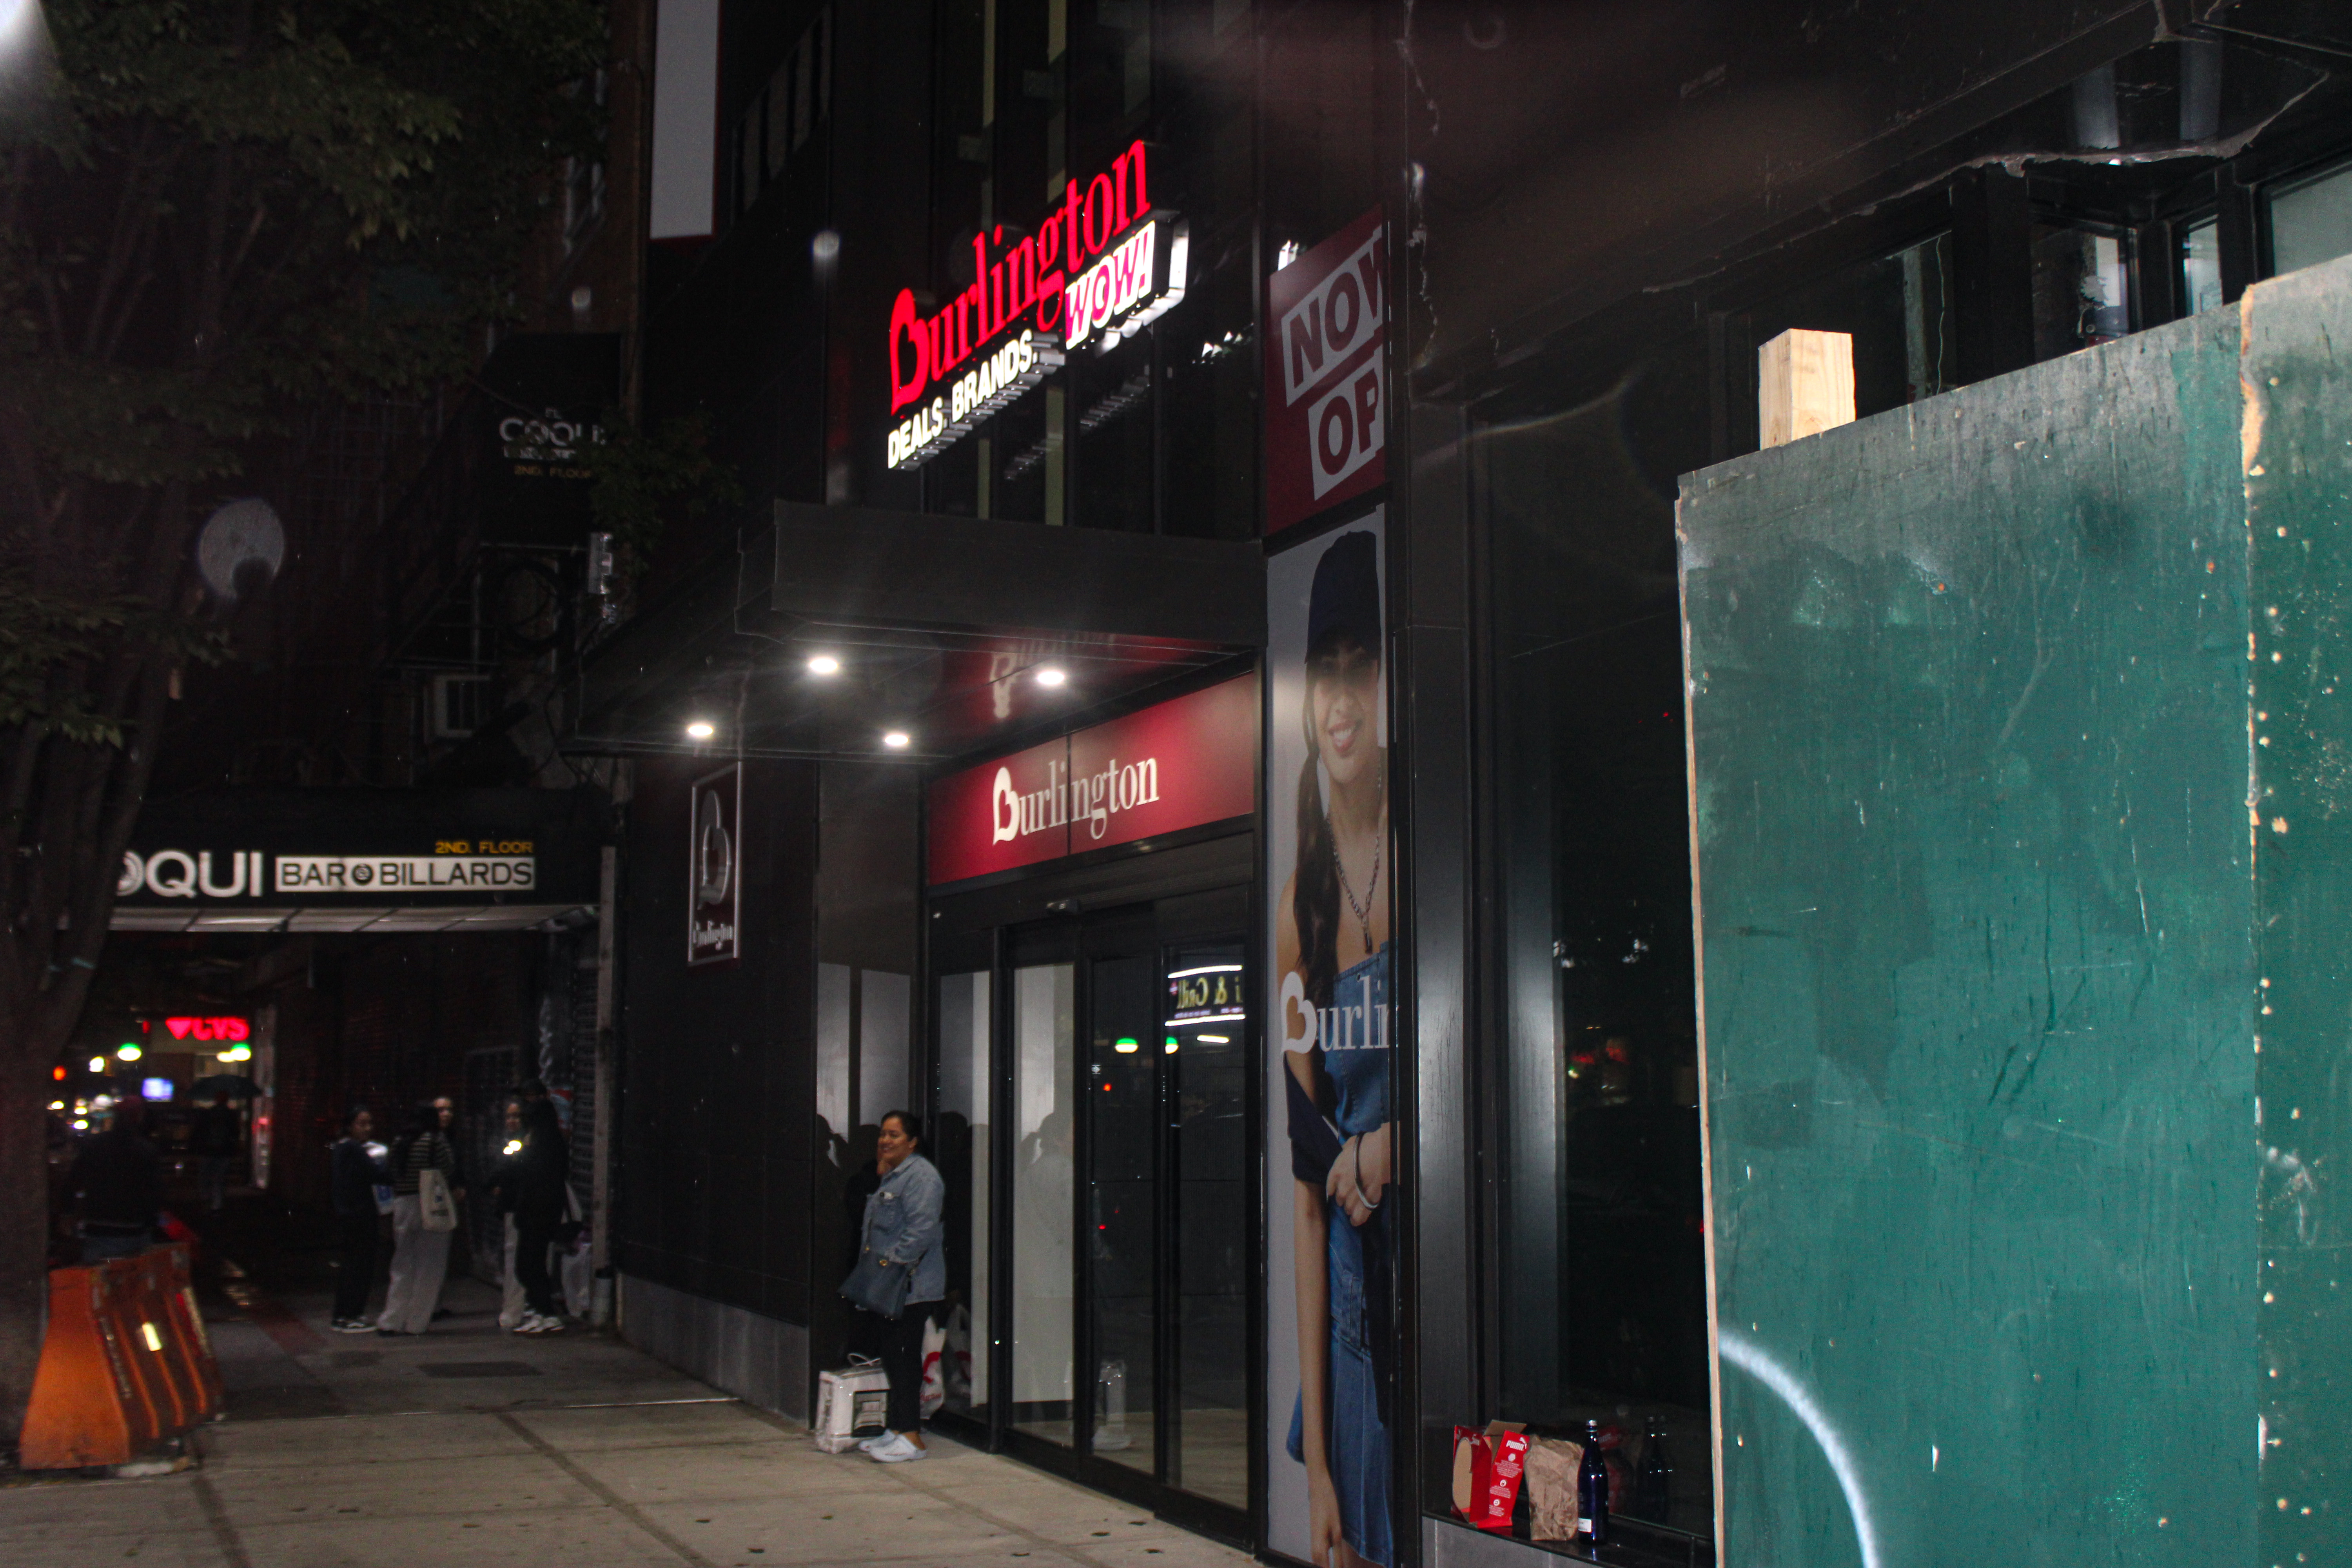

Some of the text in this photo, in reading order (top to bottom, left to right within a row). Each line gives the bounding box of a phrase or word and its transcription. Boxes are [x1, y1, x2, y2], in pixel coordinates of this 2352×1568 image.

[889, 139, 1151, 416] Burlington
[888, 220, 1156, 469] DEALS. BRANDS. WOW!
[993, 758, 1160, 846] Burlington
[479, 842, 534, 853] FLOOR
[281, 862, 532, 886] BAR BILLARDS
[192, 1016, 250, 1041] CVS
[1506, 1439, 1524, 1451] PUMA
